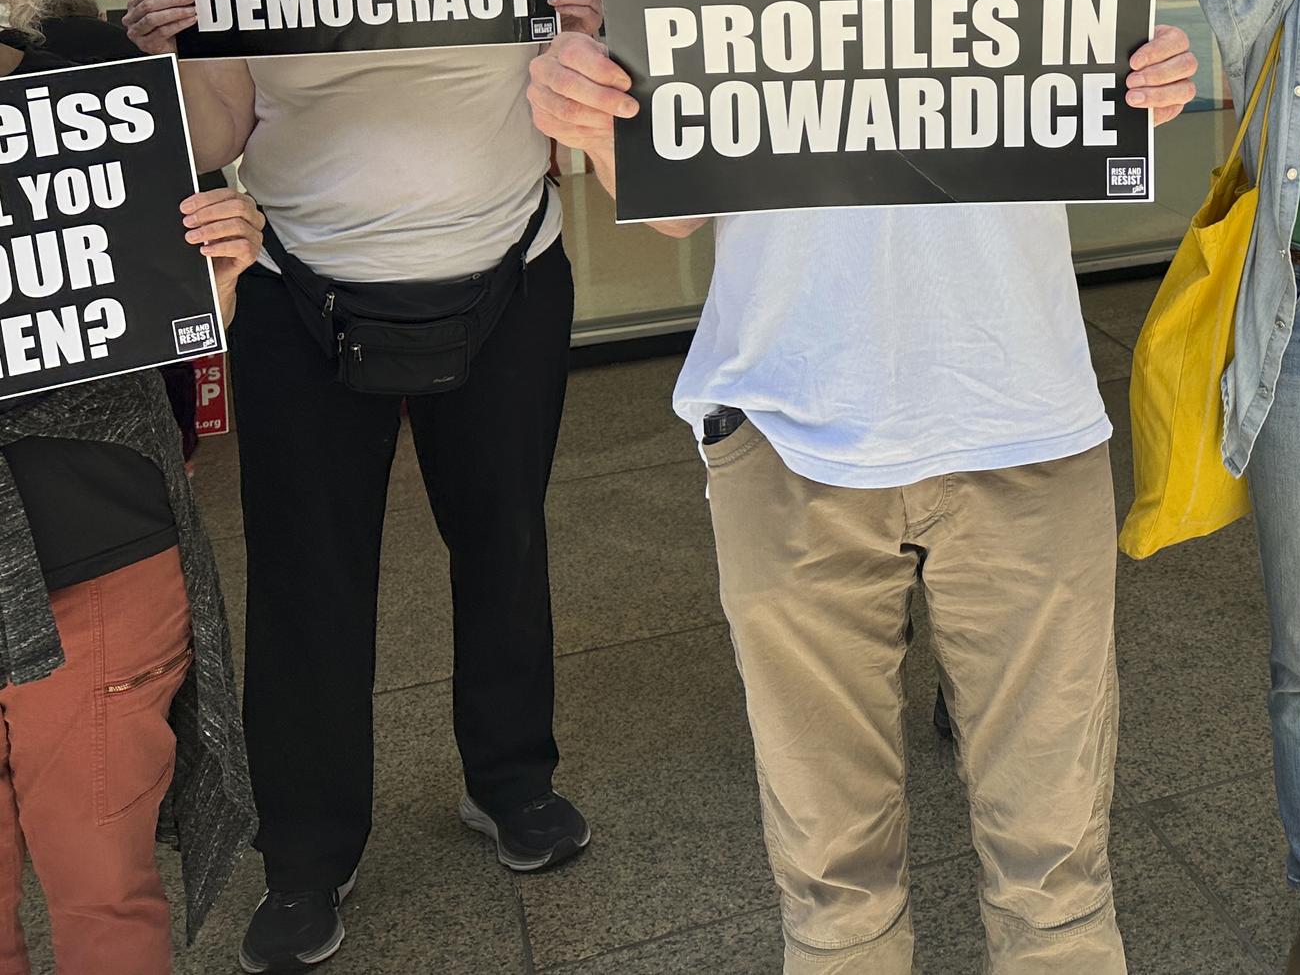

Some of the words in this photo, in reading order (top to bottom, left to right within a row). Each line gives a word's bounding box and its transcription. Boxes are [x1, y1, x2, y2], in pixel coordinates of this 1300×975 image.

[651, 72, 1118, 161] COWARDICE
[0, 85, 155, 165] eiss
[1111, 167, 1126, 176] RISE
[1128, 167, 1142, 176] AND
[1111, 175, 1142, 186] RESIST
[17, 160, 127, 221] YOU
[178, 326, 194, 336] RISE
[195, 323, 210, 332] AND
[179, 329, 211, 345] RESIST
